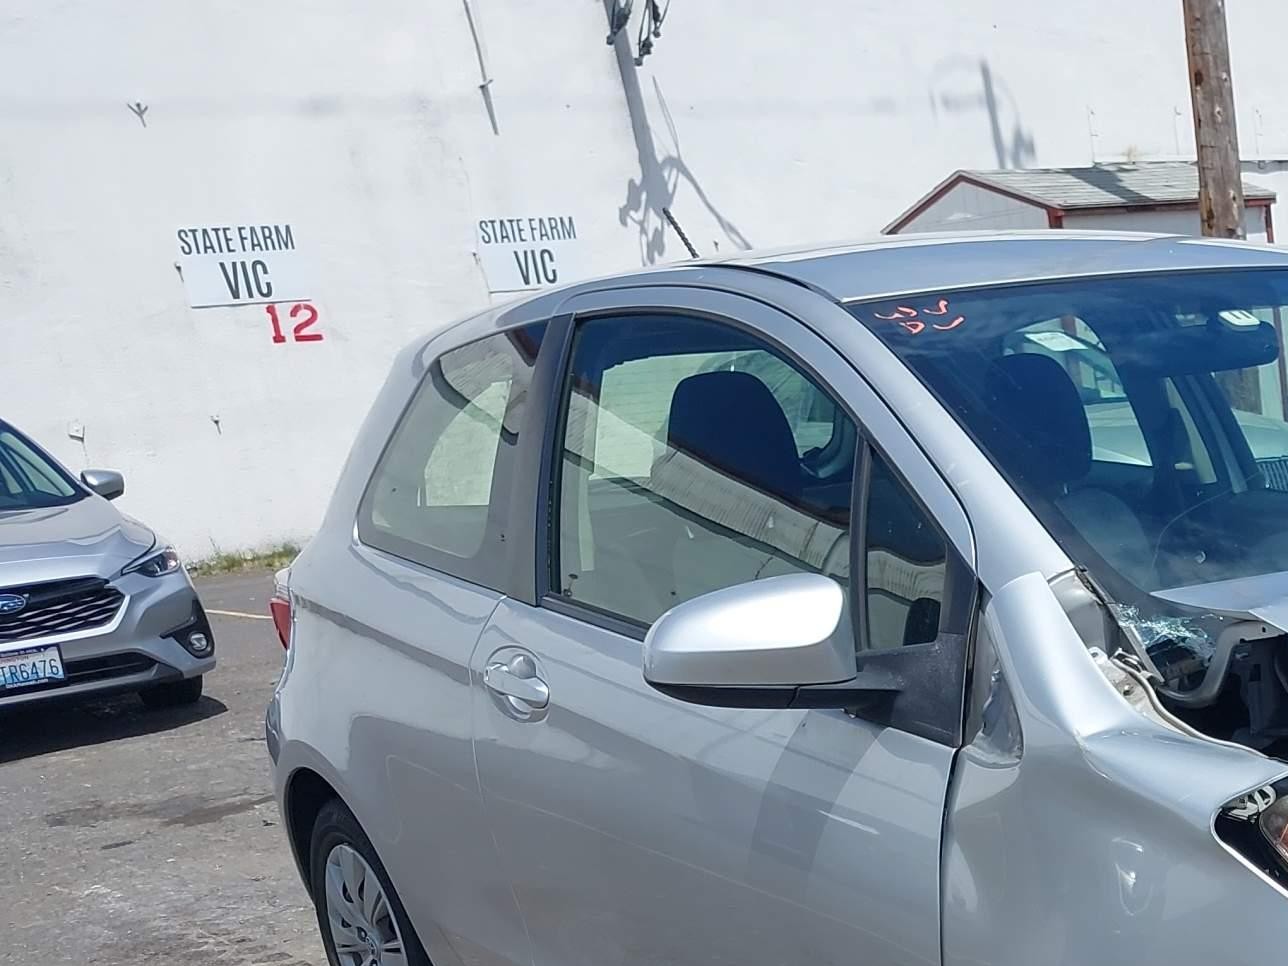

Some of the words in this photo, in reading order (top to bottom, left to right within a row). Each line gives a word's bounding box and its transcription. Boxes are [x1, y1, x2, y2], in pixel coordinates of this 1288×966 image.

[177, 227, 236, 255] STATE
[238, 224, 295, 252] FARM
[479, 218, 527, 244] STATE
[528, 216, 576, 241] FARM
[219, 259, 273, 300] VIC
[513, 248, 557, 285] VIC
[266, 303, 323, 343] 12
